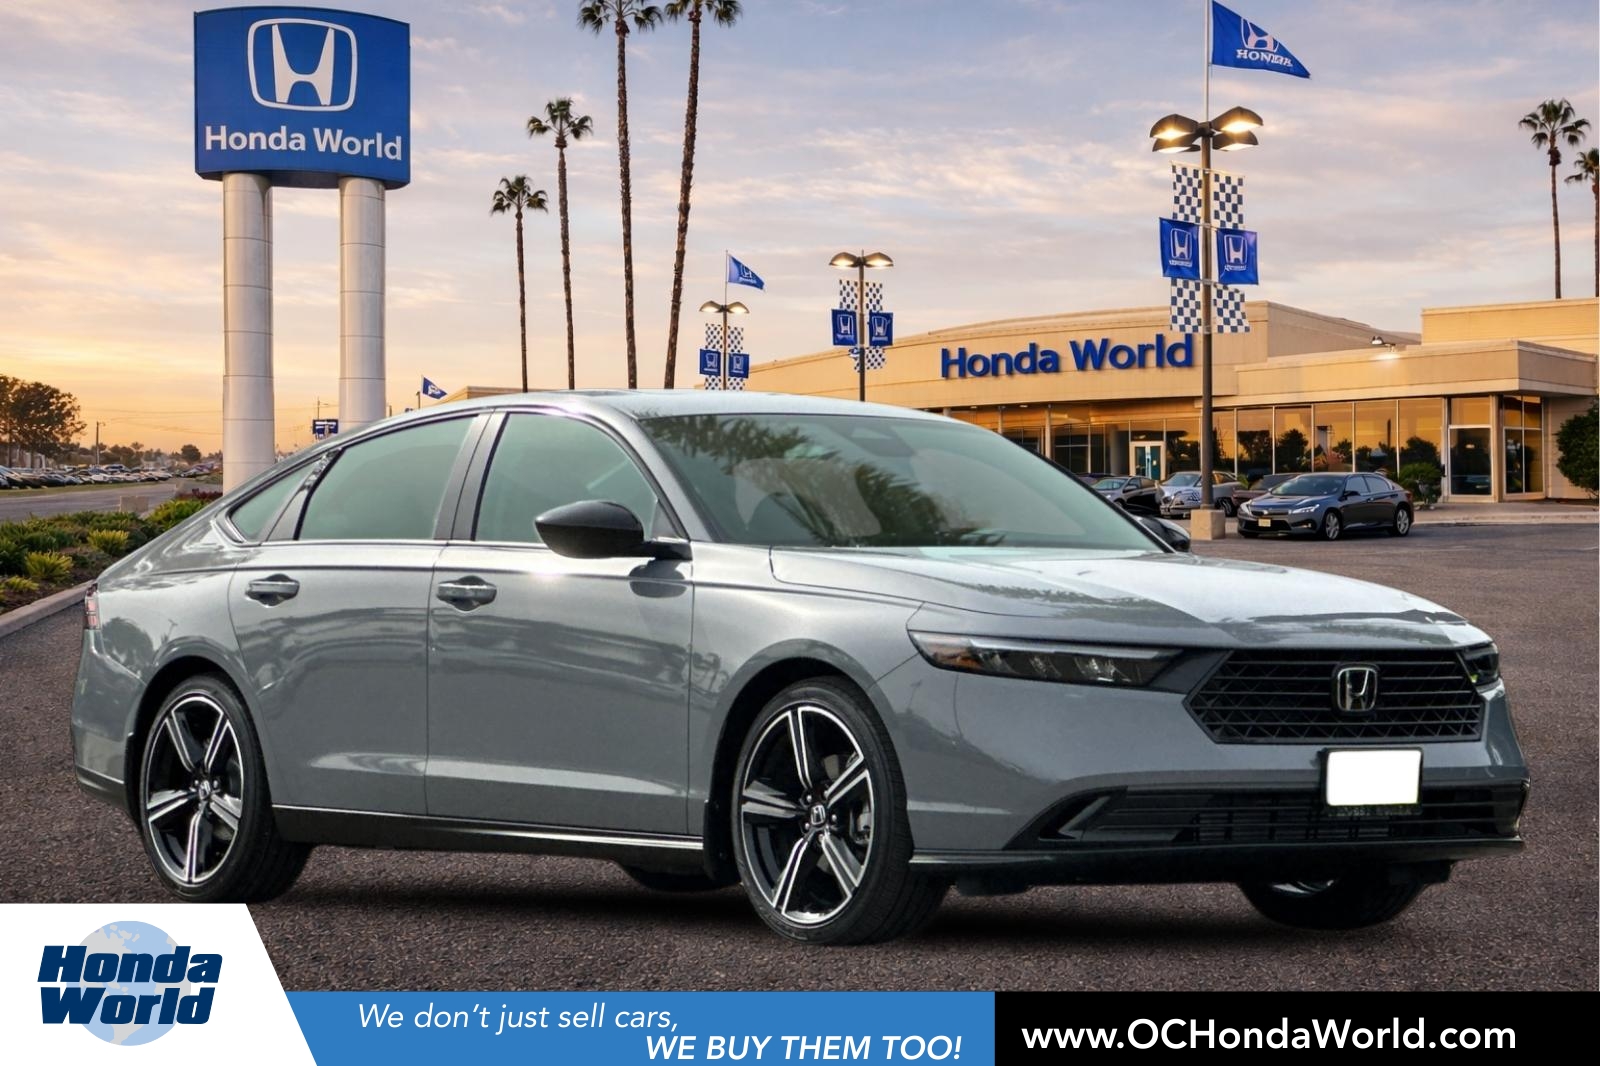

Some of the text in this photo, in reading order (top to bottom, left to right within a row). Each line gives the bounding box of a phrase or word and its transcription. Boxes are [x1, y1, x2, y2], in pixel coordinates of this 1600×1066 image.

[205, 125, 402, 161] Honda World
[941, 333, 1194, 378] Honda World
